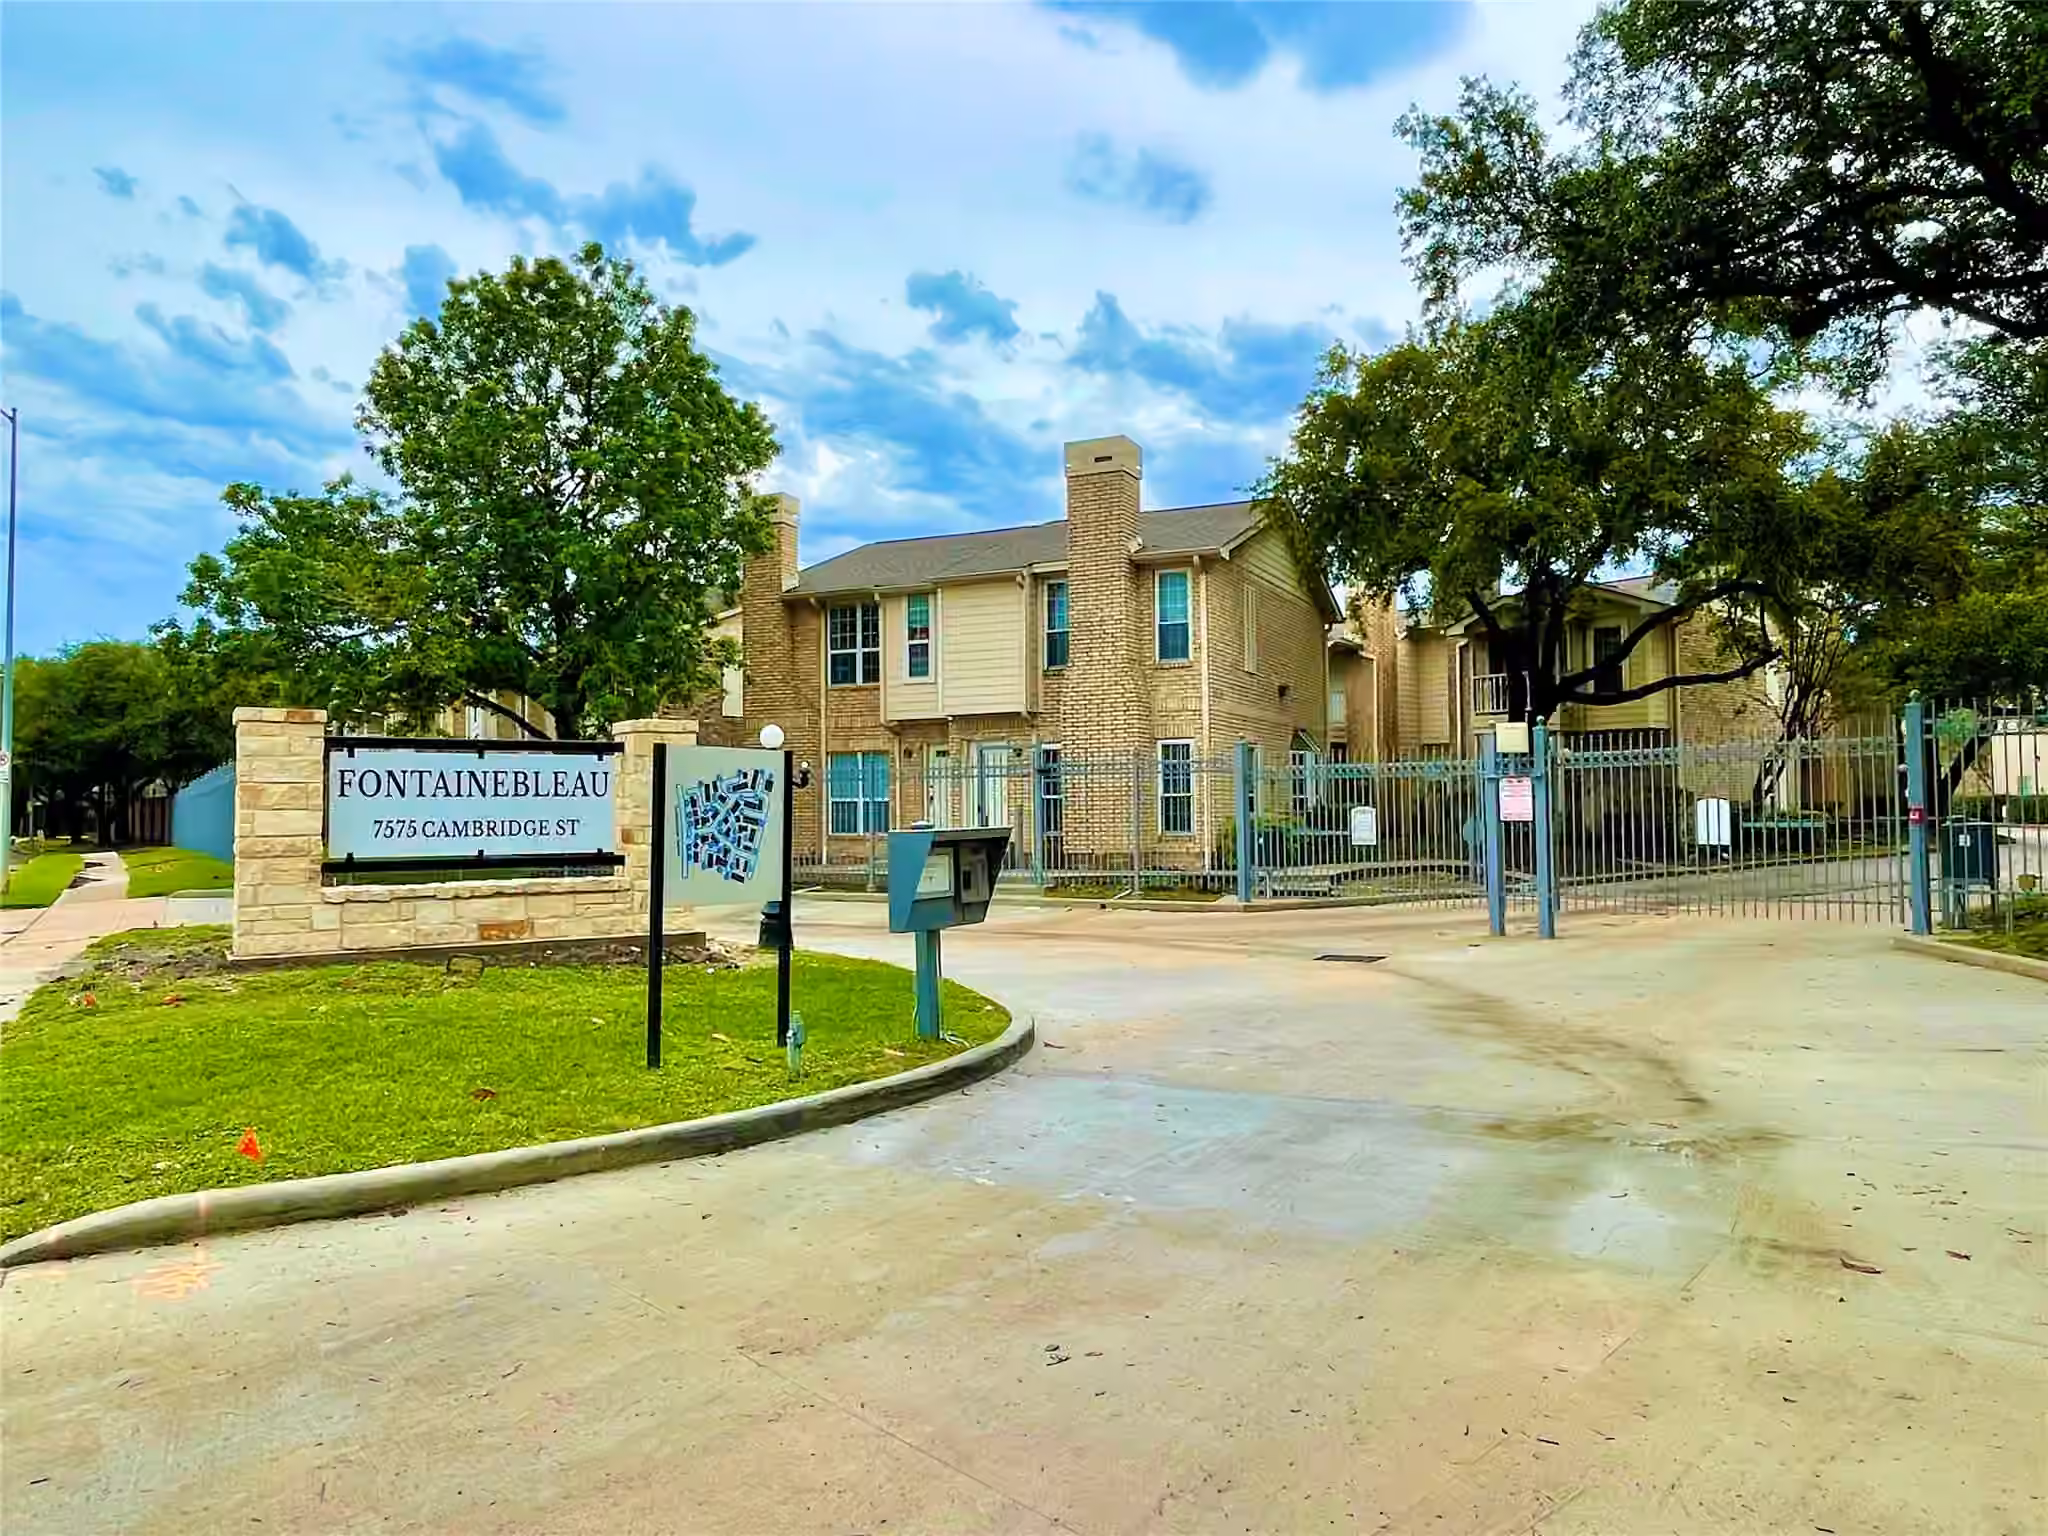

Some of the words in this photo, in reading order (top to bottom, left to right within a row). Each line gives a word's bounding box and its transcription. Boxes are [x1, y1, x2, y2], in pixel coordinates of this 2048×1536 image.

[337, 769, 609, 798] FONTAINEBLEAU
[373, 820, 417, 838] 7575
[422, 819, 550, 838] CAMBRIDGE
[555, 818, 581, 836] ST
